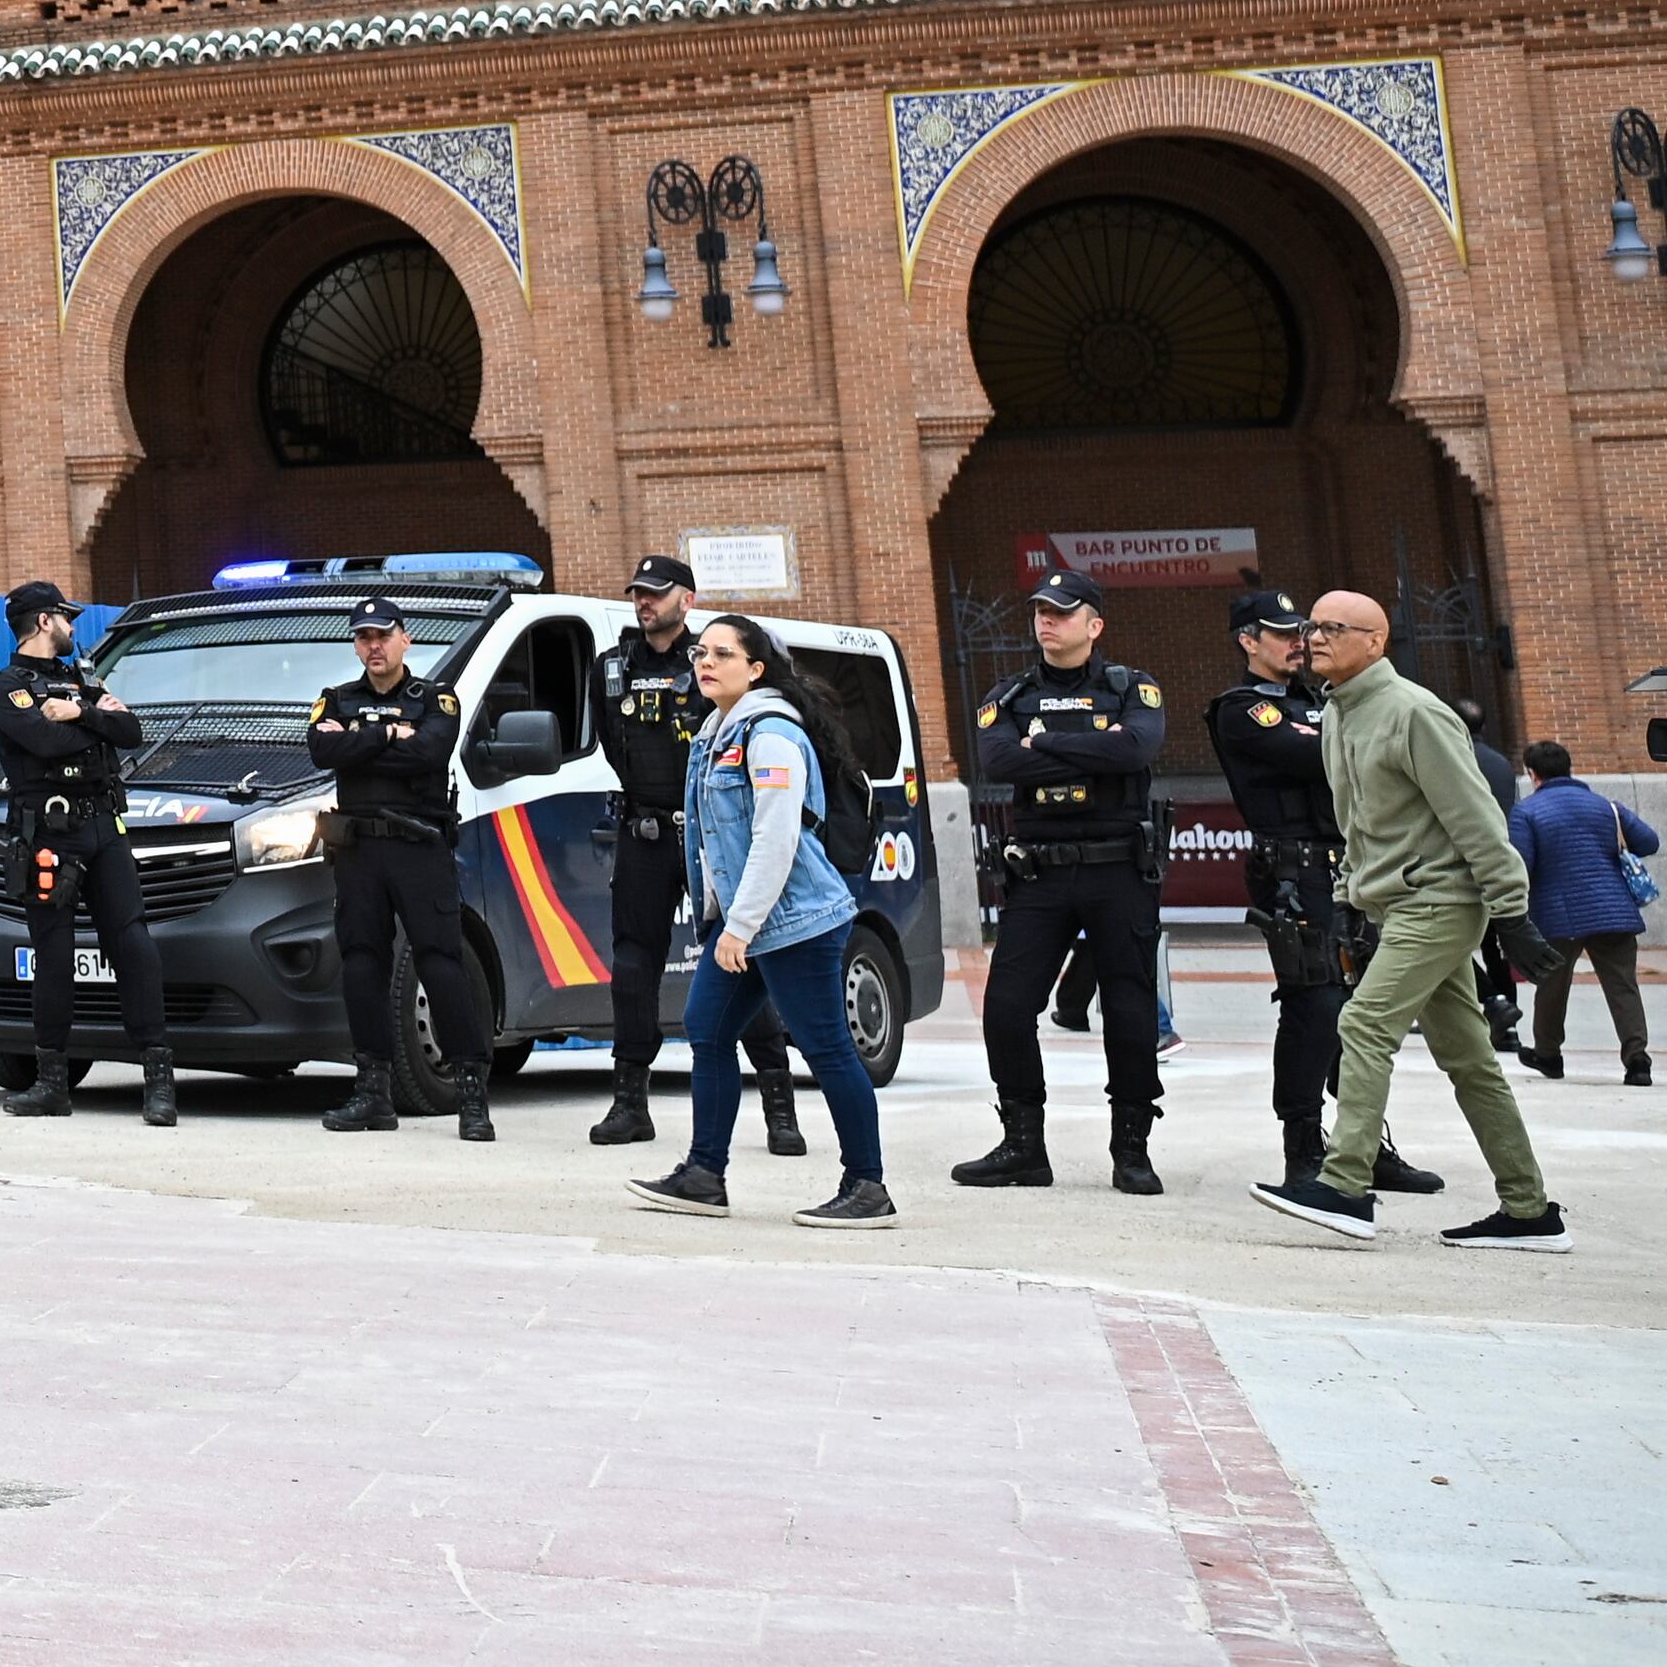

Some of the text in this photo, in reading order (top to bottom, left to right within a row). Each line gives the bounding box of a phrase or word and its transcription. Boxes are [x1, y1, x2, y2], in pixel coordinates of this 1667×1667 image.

[1075, 537, 1222, 556] BAR PUNTO DE
[1090, 558, 1211, 576] ENCUENTRO
[1169, 822, 1254, 851] ahou
